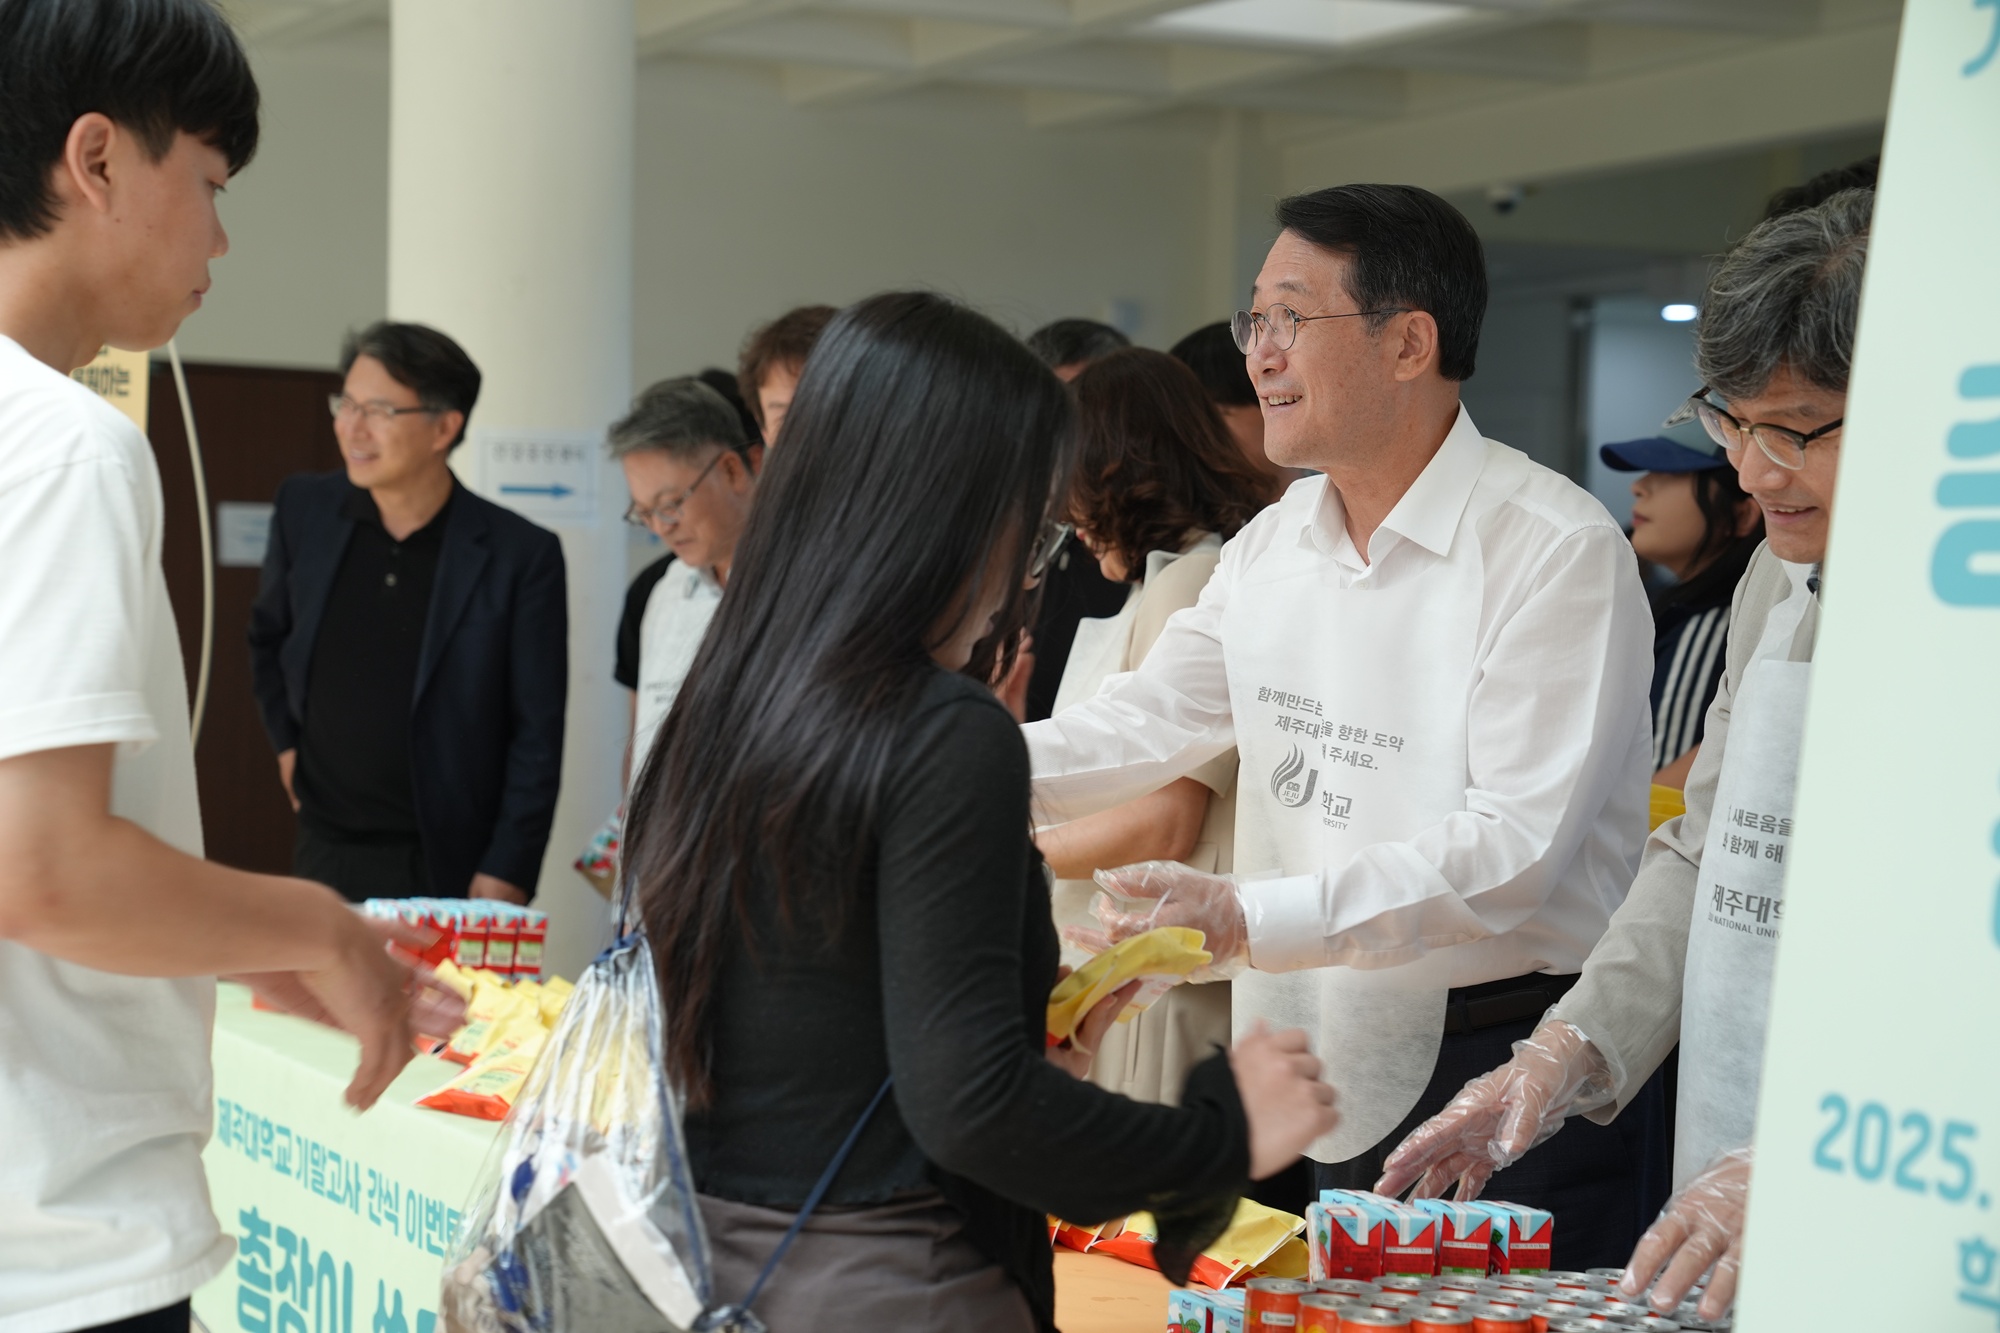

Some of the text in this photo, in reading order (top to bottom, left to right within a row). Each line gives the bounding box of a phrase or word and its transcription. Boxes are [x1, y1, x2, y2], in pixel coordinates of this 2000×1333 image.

[1274, 714, 1324, 740] 제주대
[1329, 746, 1379, 771] 주세요.
[1338, 724, 1368, 745] 향한
[1372, 732, 1405, 753] 도약
[1282, 790, 1300, 800] JEJU
[1323, 817, 1348, 830] ERSITY
[1730, 834, 1759, 859] 함께
[1765, 844, 1784, 863] 해
[1713, 915, 1753, 934] NATIONAL
[1812, 1092, 1992, 1210] 2025.
[367, 1167, 401, 1238] 간식
